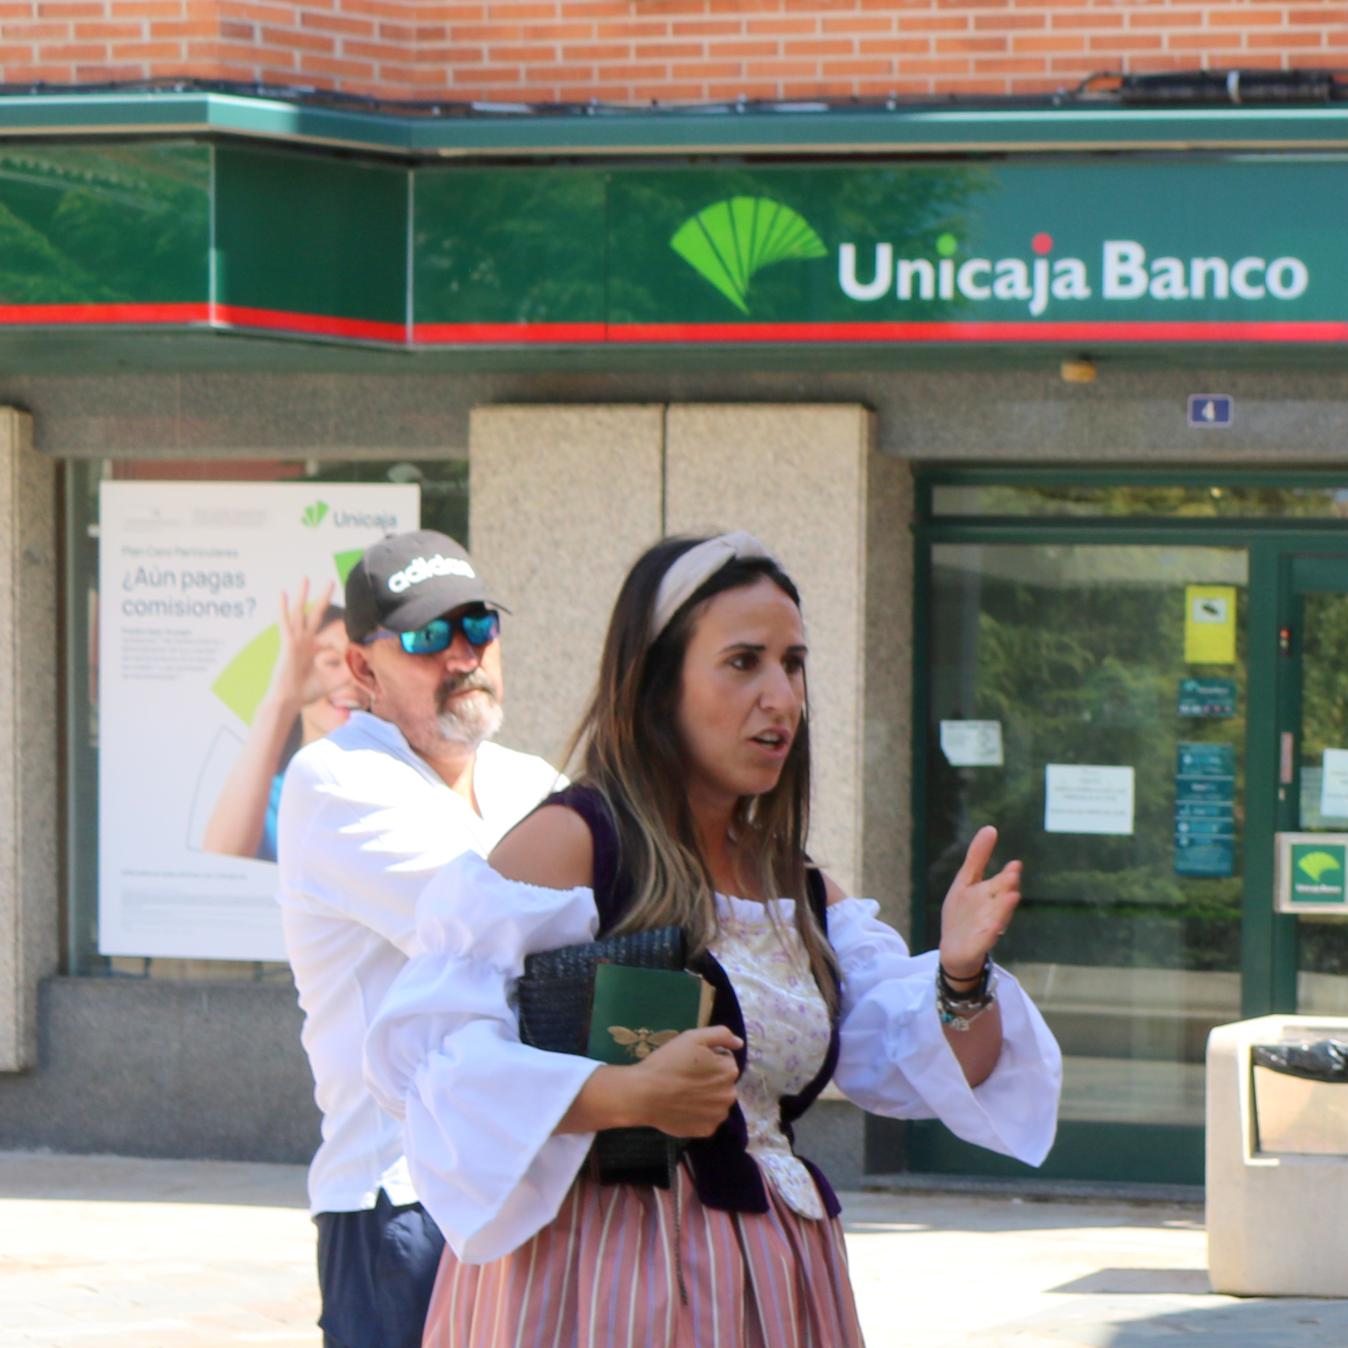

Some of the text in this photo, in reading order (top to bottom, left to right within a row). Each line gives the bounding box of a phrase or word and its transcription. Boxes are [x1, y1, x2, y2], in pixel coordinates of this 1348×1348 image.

[838, 233, 1309, 317] Unicaja Banco
[1201, 400, 1216, 422] 4
[333, 510, 398, 533] Unicaja
[122, 565, 246, 595] ¿Aún pagas
[387, 553, 476, 593] adidas
[121, 596, 257, 618] comisiones?
